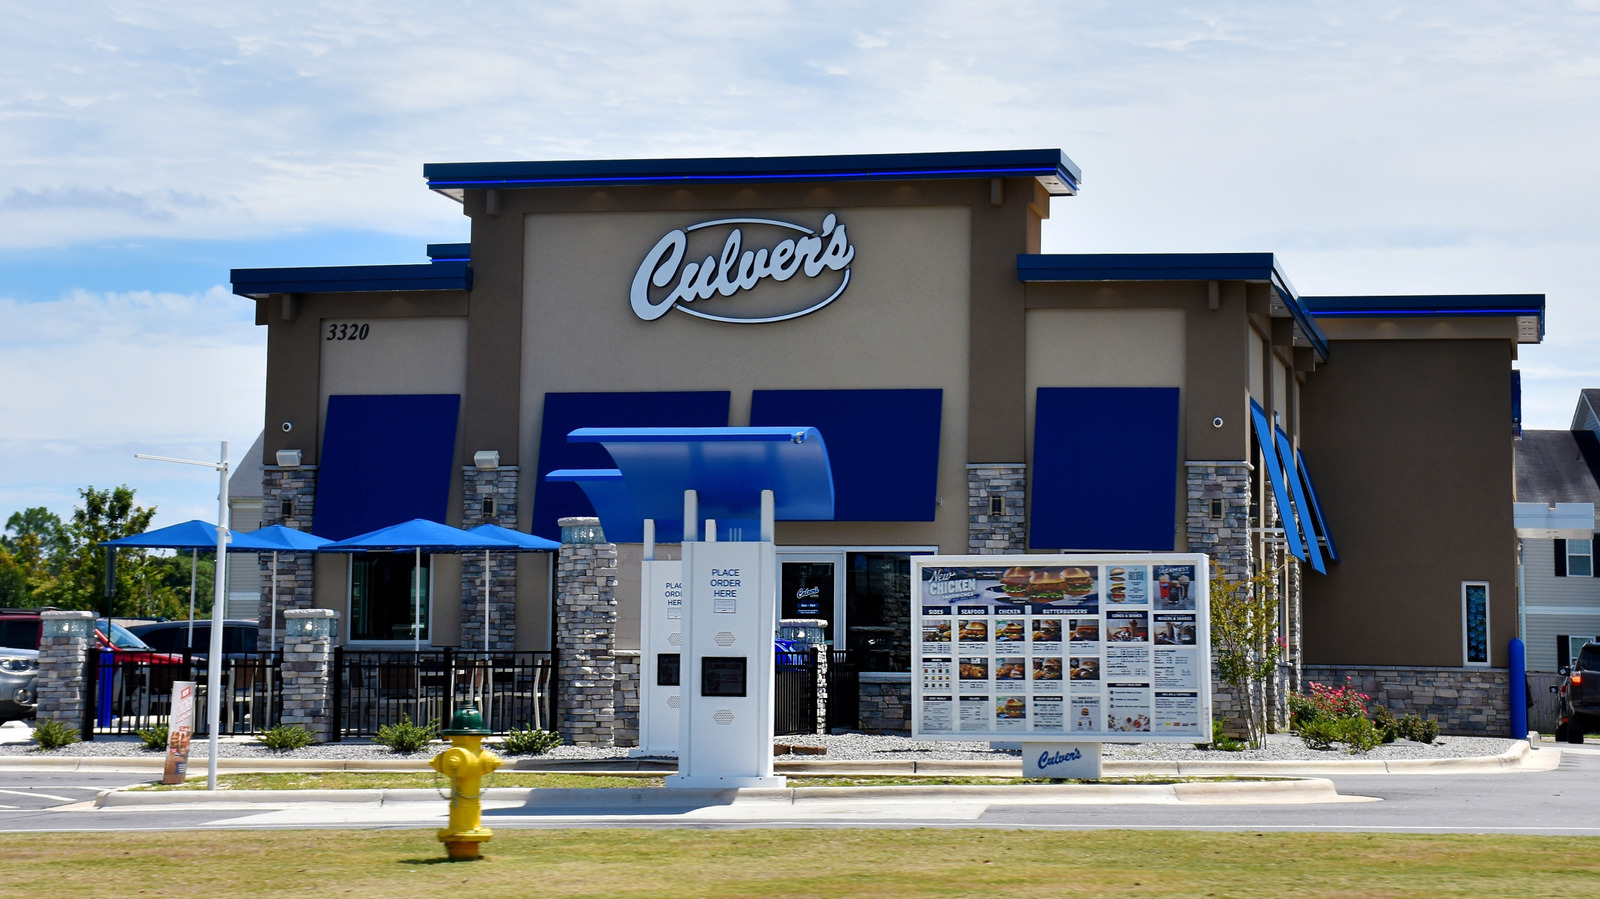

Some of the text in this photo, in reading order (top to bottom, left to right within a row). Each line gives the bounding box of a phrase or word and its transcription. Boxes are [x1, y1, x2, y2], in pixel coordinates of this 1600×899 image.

[630, 213, 855, 321] Culver's
[326, 323, 370, 341] 3320
[712, 568, 740, 577] PLACE
[928, 569, 956, 583] New
[929, 578, 976, 596] CHICKEN
[1038, 748, 1082, 769] Culver's
